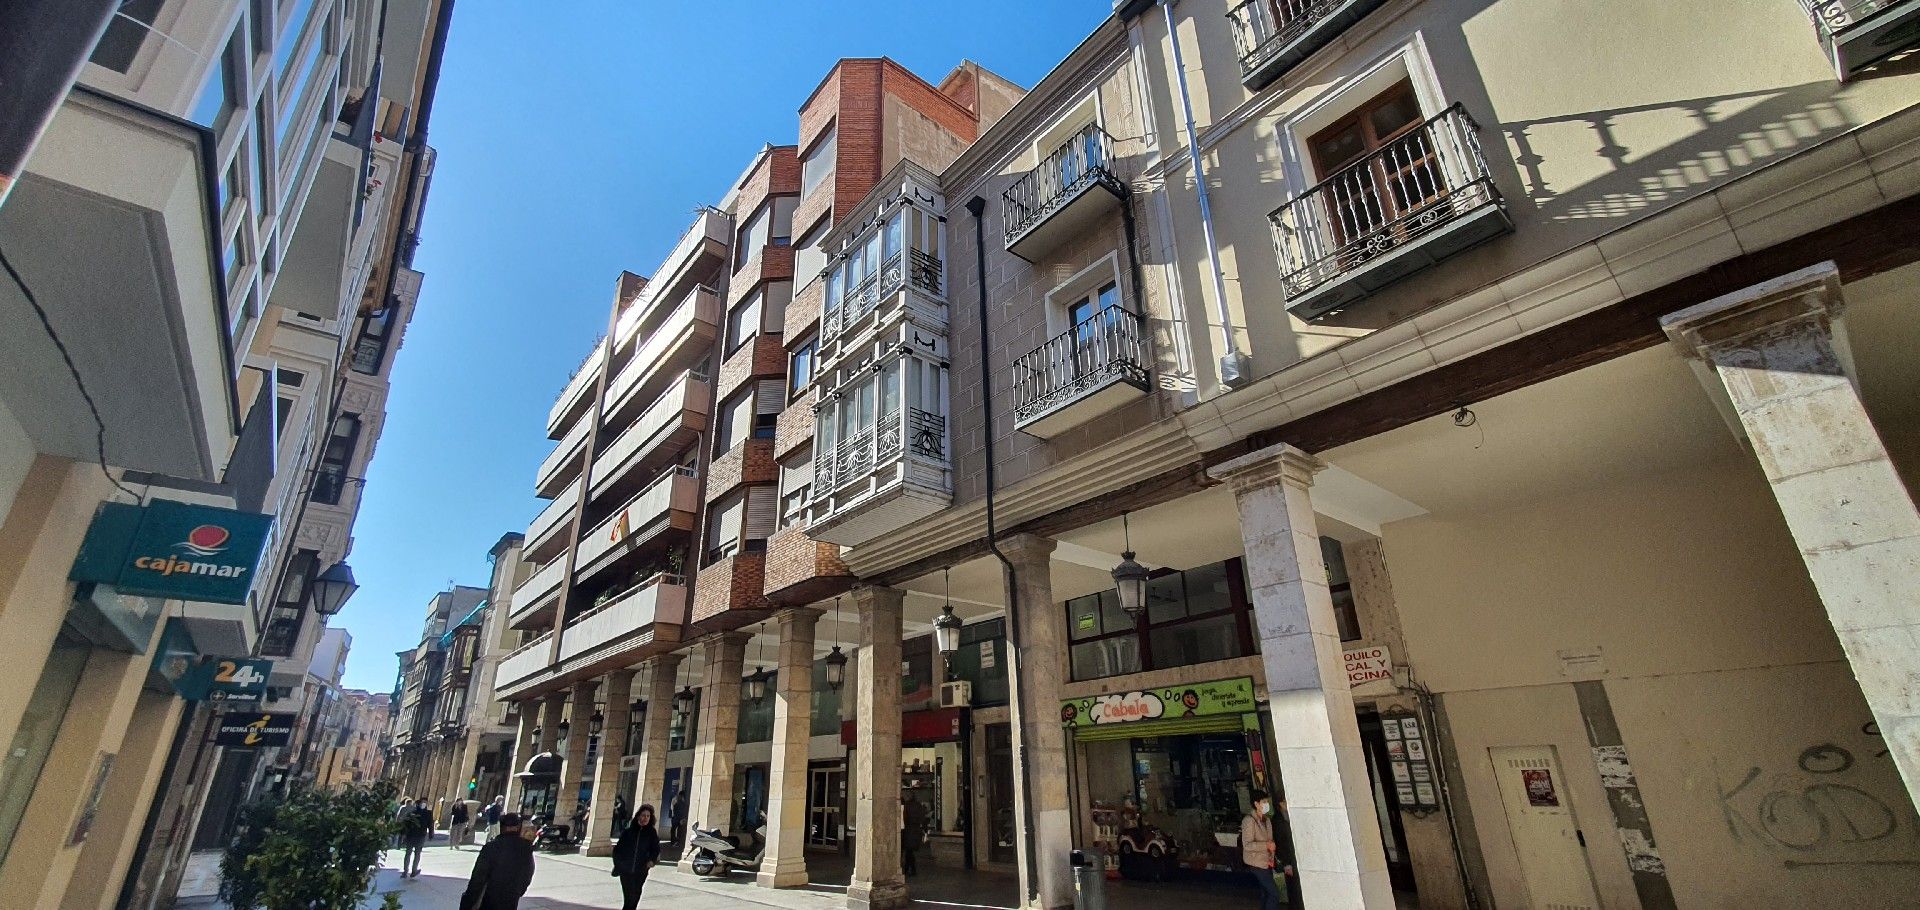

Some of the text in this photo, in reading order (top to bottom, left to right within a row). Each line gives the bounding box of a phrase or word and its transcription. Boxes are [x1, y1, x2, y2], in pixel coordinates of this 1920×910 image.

[134, 554, 248, 579] cajamar
[1344, 650, 1382, 662] QUILO
[1345, 659, 1386, 672] CAL Y
[214, 661, 265, 687] 24h
[1349, 669, 1393, 681] ICINA
